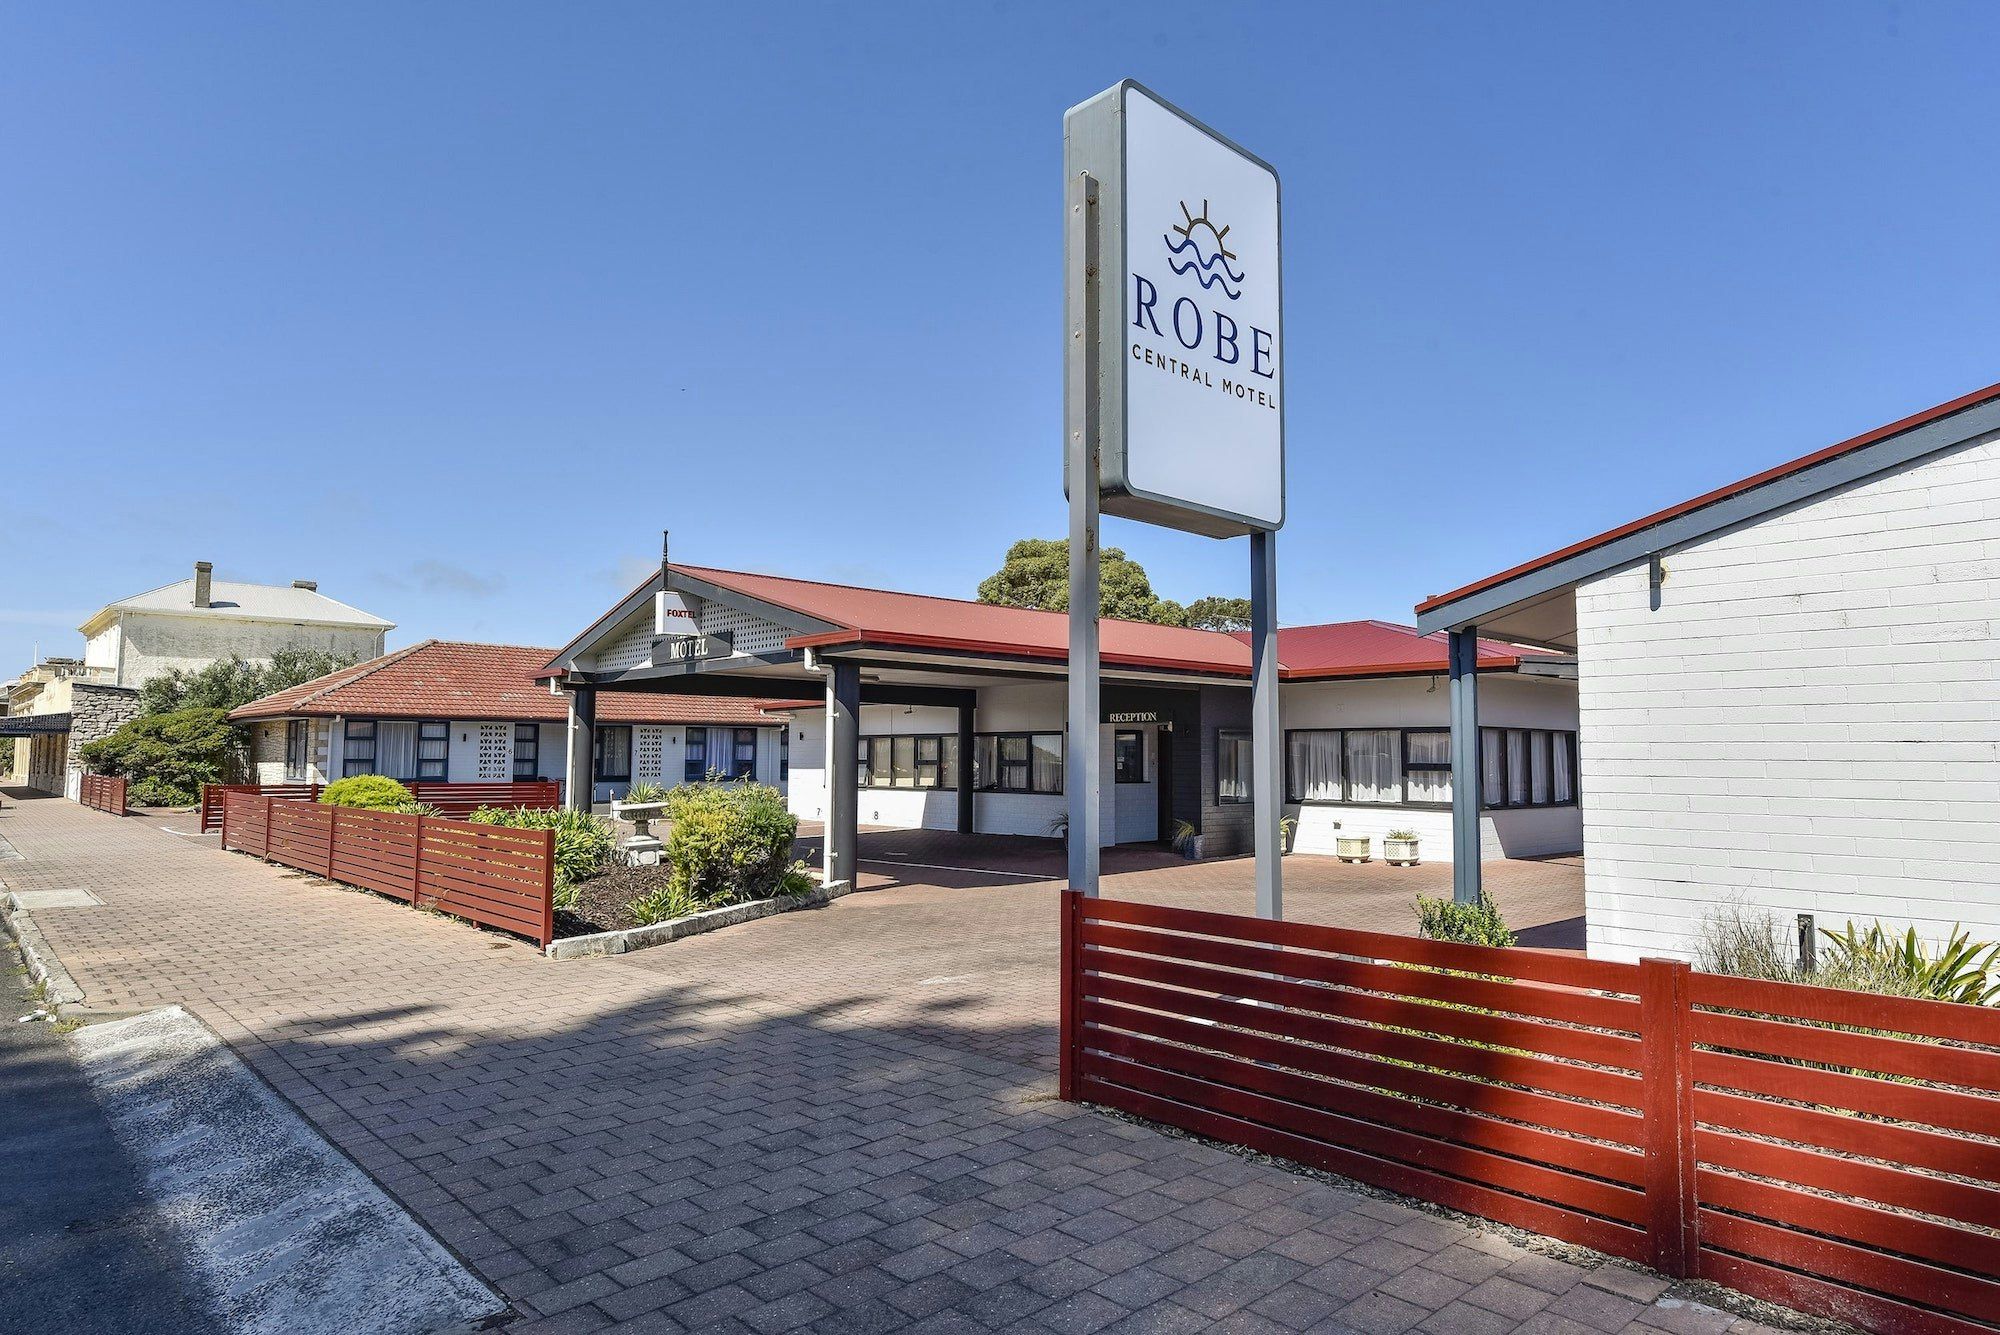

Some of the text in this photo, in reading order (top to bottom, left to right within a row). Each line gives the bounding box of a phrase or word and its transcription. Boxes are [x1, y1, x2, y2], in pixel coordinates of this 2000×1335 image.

[1132, 273, 1275, 380] ROBE
[1132, 344, 1276, 410] CENTRAL MOTEL
[667, 609, 696, 619] FOXTEL
[670, 638, 708, 660] MOTEL
[1109, 712, 1157, 723] RECEPTION
[873, 811, 879, 820] 8
